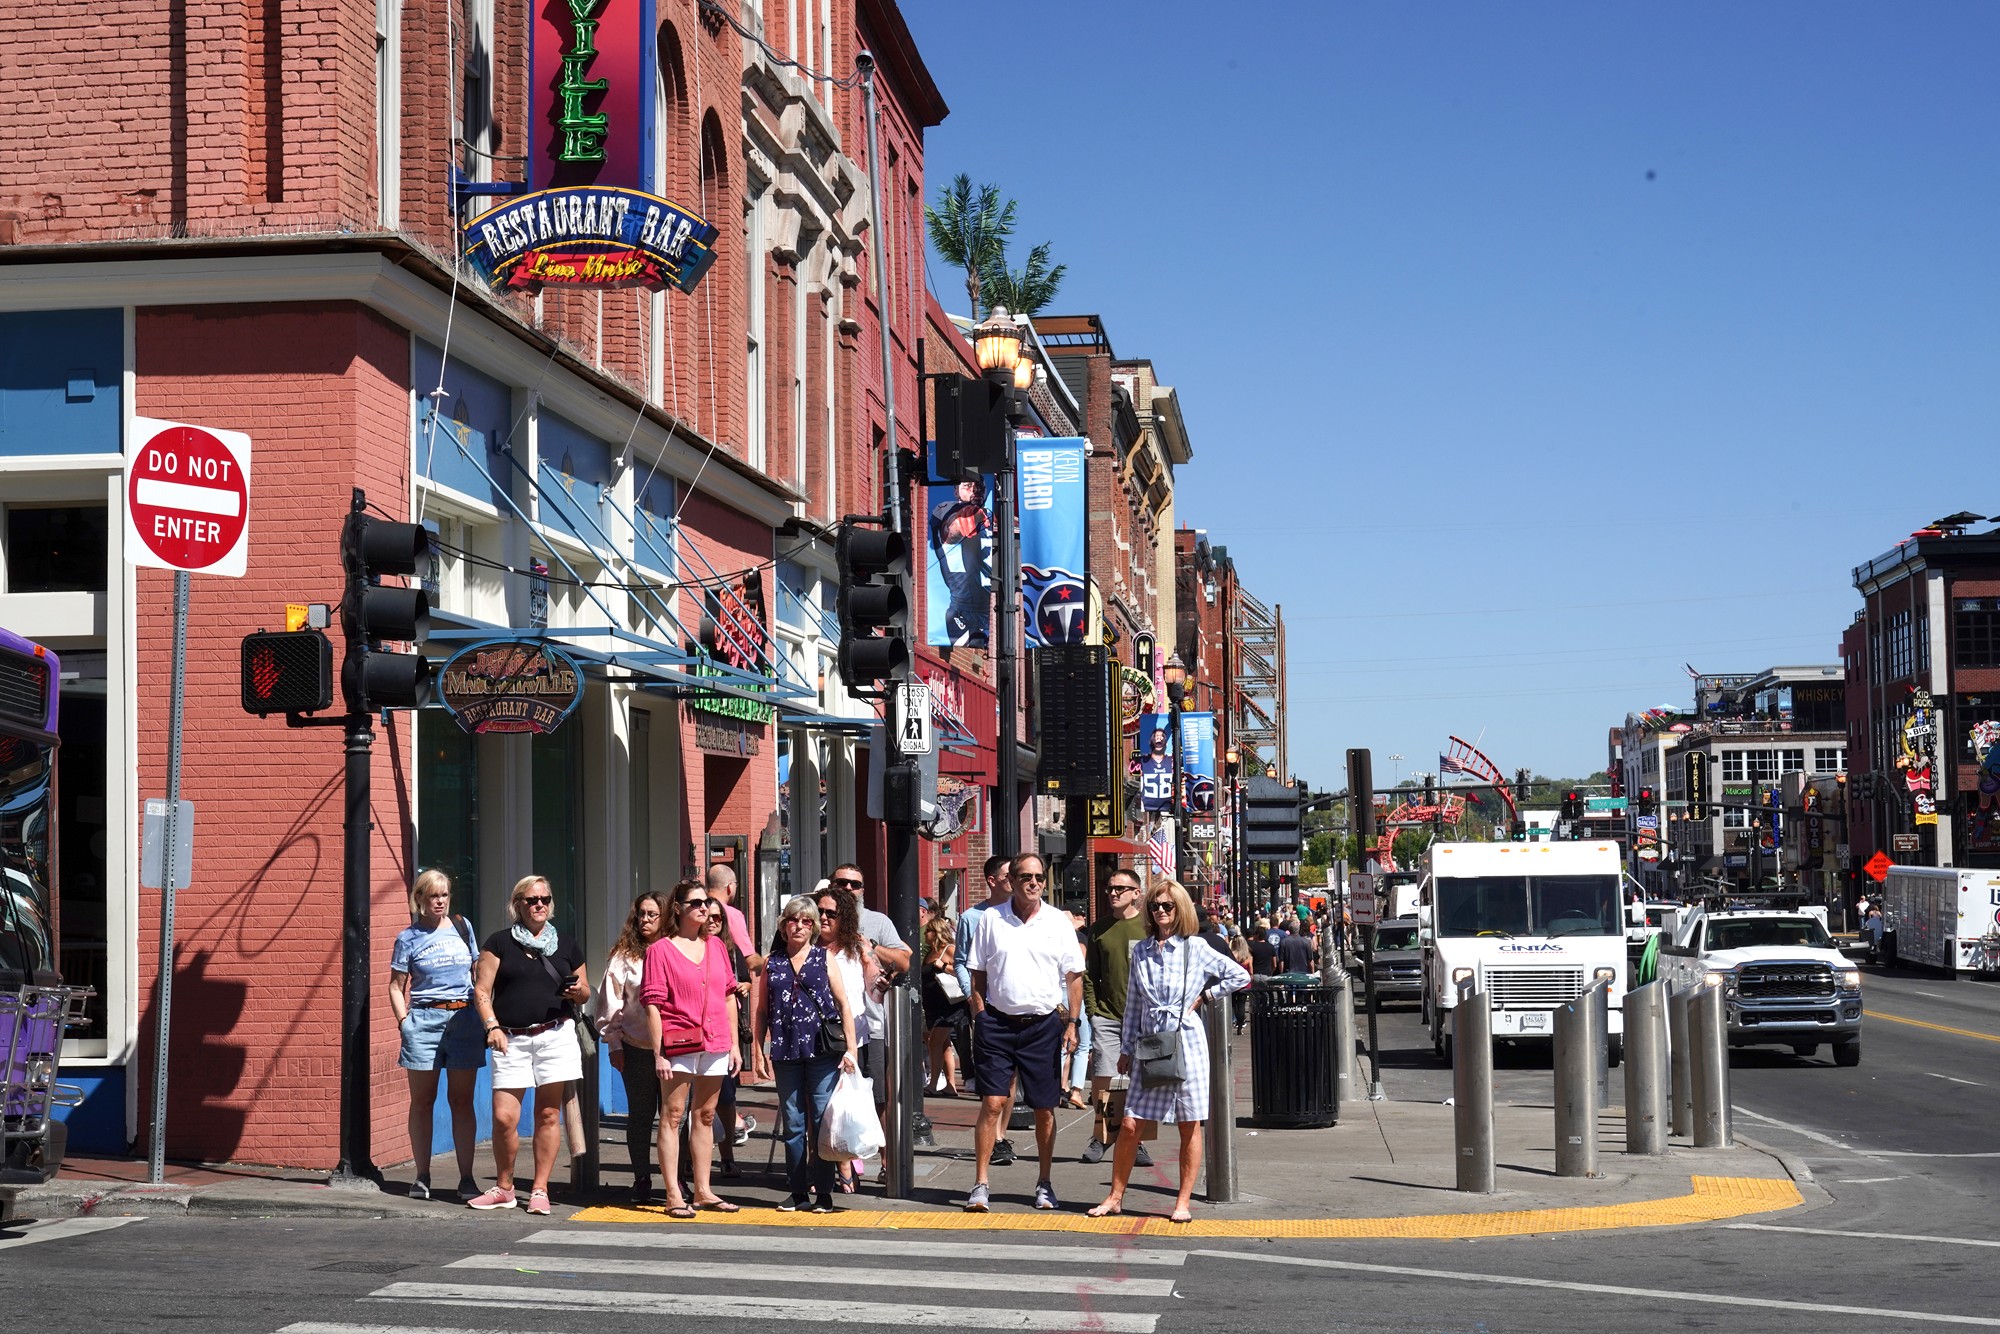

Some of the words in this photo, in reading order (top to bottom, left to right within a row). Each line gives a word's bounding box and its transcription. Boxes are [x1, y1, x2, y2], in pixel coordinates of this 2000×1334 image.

[481, 194, 630, 259] RESTAURANT
[641, 204, 692, 260] BAR
[528, 254, 576, 278] Live
[580, 254, 644, 279] Music
[149, 449, 178, 475] DO
[188, 455, 232, 482] NOT
[1054, 450, 1080, 483] KEVIN
[1022, 450, 1053, 511] BYARD
[154, 514, 221, 544] ENTER
[1796, 688, 1843, 701] WHISKEY
[1916, 690, 1929, 698] KID
[464, 701, 529, 725] RESTAURANT
[533, 705, 556, 725] BAR
[909, 707, 919, 717] ON
[1183, 717, 1200, 752] LANDRY
[1913, 726, 1928, 735] BIG
[903, 740, 926, 751] SIGNAL
[1691, 752, 1700, 791] WHISKEY
[1192, 824, 1215, 832] OLE
[1358, 880, 1366, 889] NO
[1352, 892, 1373, 901] VENDING
[1766, 974, 1807, 982] RAM
